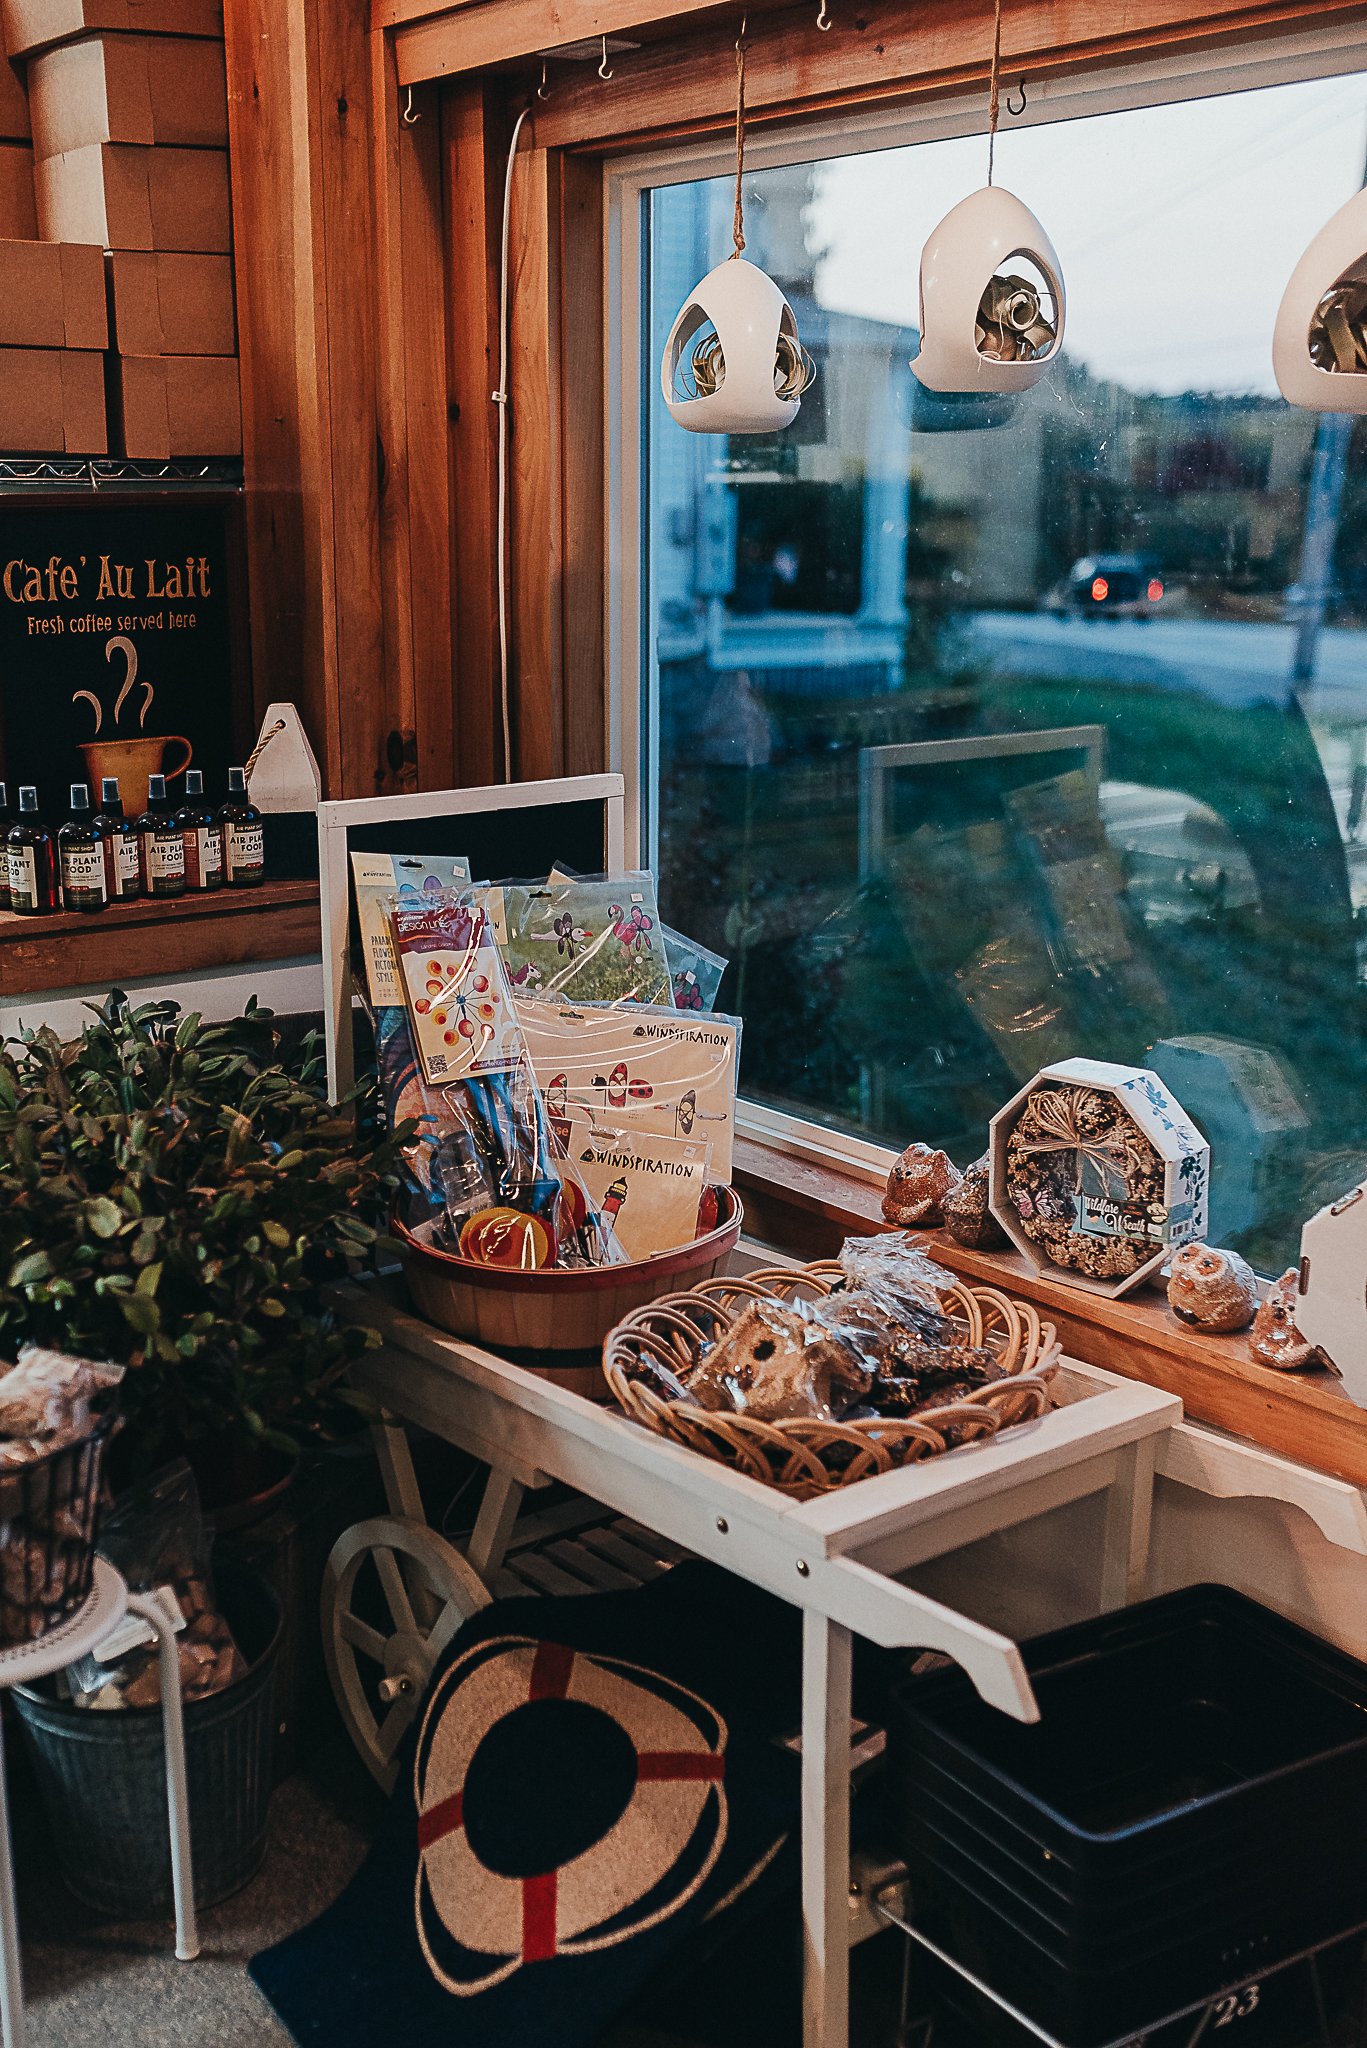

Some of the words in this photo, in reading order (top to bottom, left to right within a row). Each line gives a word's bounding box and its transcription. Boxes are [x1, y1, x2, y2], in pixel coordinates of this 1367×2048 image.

[3, 556, 87, 603] Cafe'
[96, 554, 136, 601] Au
[144, 556, 211, 598] Lait
[27, 616, 65, 635] Fresh
[69, 613, 112, 633] coffee
[117, 611, 163, 631] served
[169, 611, 197, 630] here
[204, 840, 217, 849] AIR
[230, 836, 246, 844] AIR
[248, 834, 262, 843] PLA
[119, 847, 134, 856] AIR
[150, 846, 167, 854] AIR
[169, 844, 182, 853] PLA
[72, 855, 102, 865] PLANT
[65, 865, 92, 874] FOOD
[397, 919, 428, 932] DESIGN
[376, 972, 394, 983] STYLE
[646, 1024, 729, 1047] WINDSPIRATION
[597, 1150, 694, 1178] WINDSPIRATION
[1104, 1213, 1146, 1233] Wreath
[1214, 1984, 1260, 2029] 23
